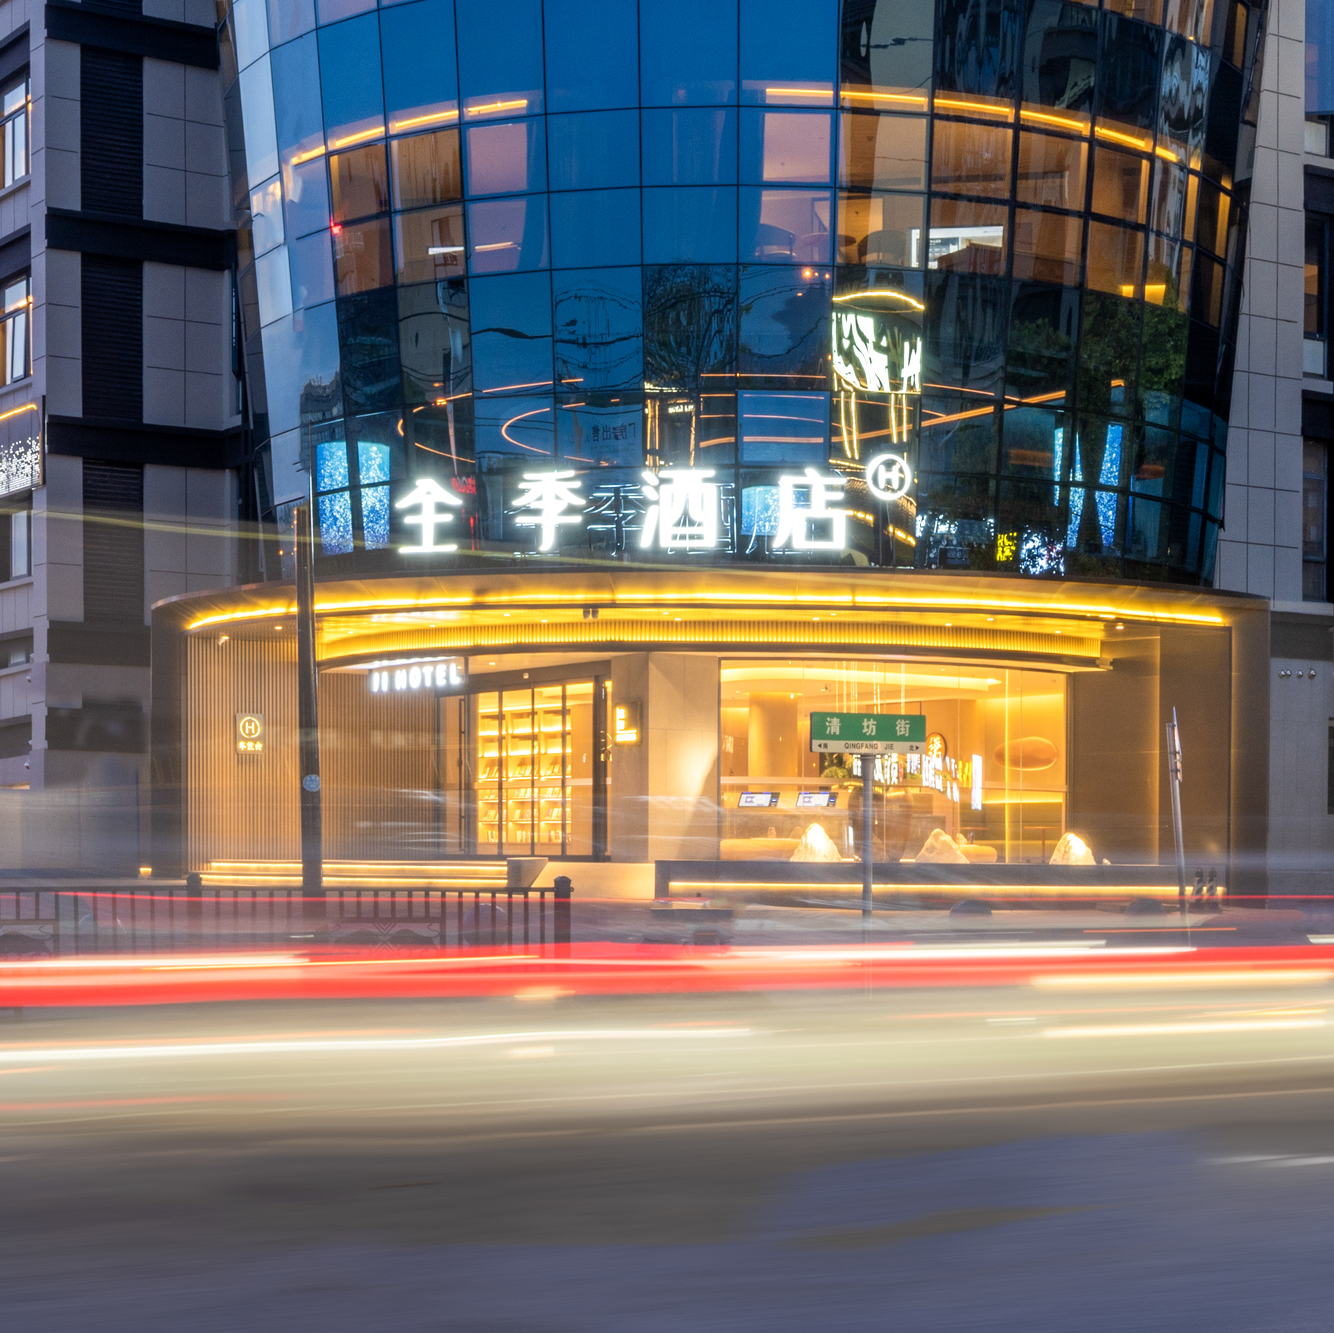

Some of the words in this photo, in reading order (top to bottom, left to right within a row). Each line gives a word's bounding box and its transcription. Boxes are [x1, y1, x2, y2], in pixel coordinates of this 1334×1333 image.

[395, 468, 847, 554] 全季酒店
[395, 664, 461, 690] HOTEL
[825, 717, 910, 737] 清坊街
[844, 742, 879, 751] QINGFANG
[884, 743, 895, 751] JIE
